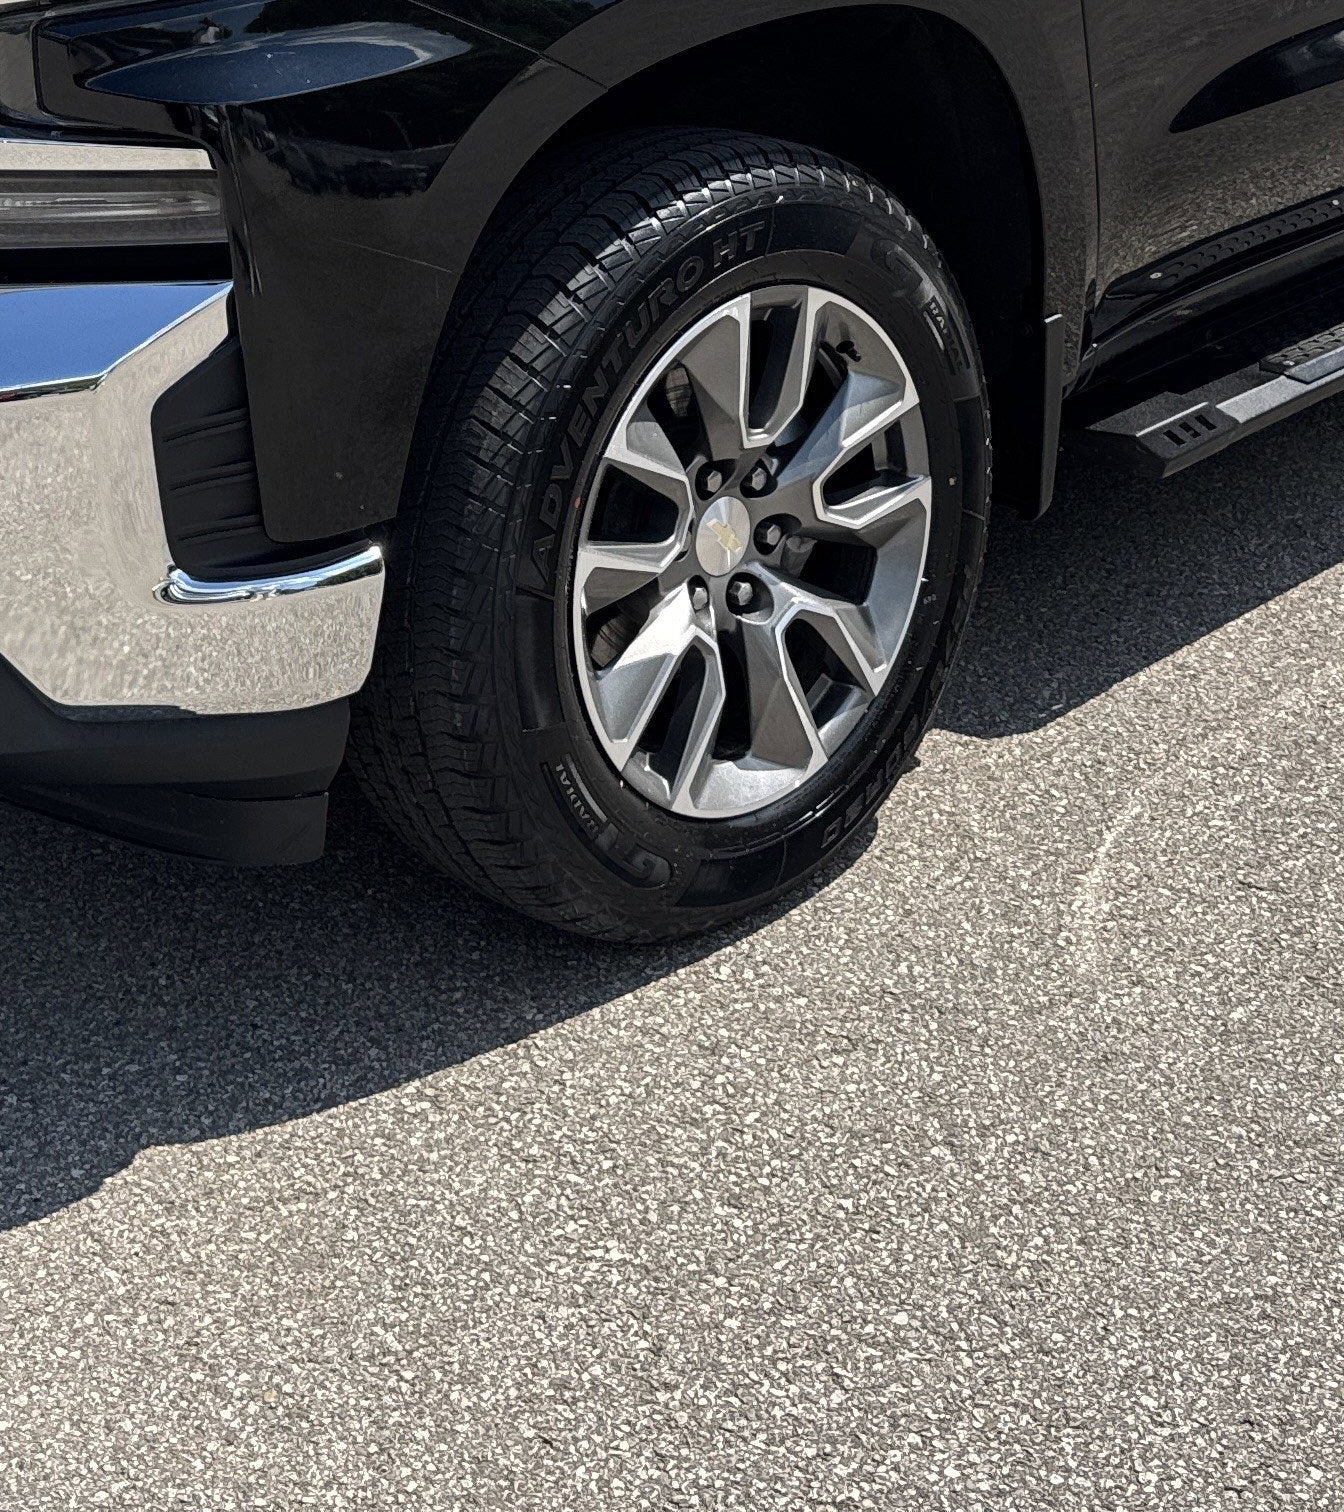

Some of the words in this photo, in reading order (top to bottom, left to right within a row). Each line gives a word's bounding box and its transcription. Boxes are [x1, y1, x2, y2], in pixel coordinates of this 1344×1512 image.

[531, 254, 704, 587] ADVENTURO
[713, 220, 765, 268] HT
[555, 763, 600, 835] RADIAL
